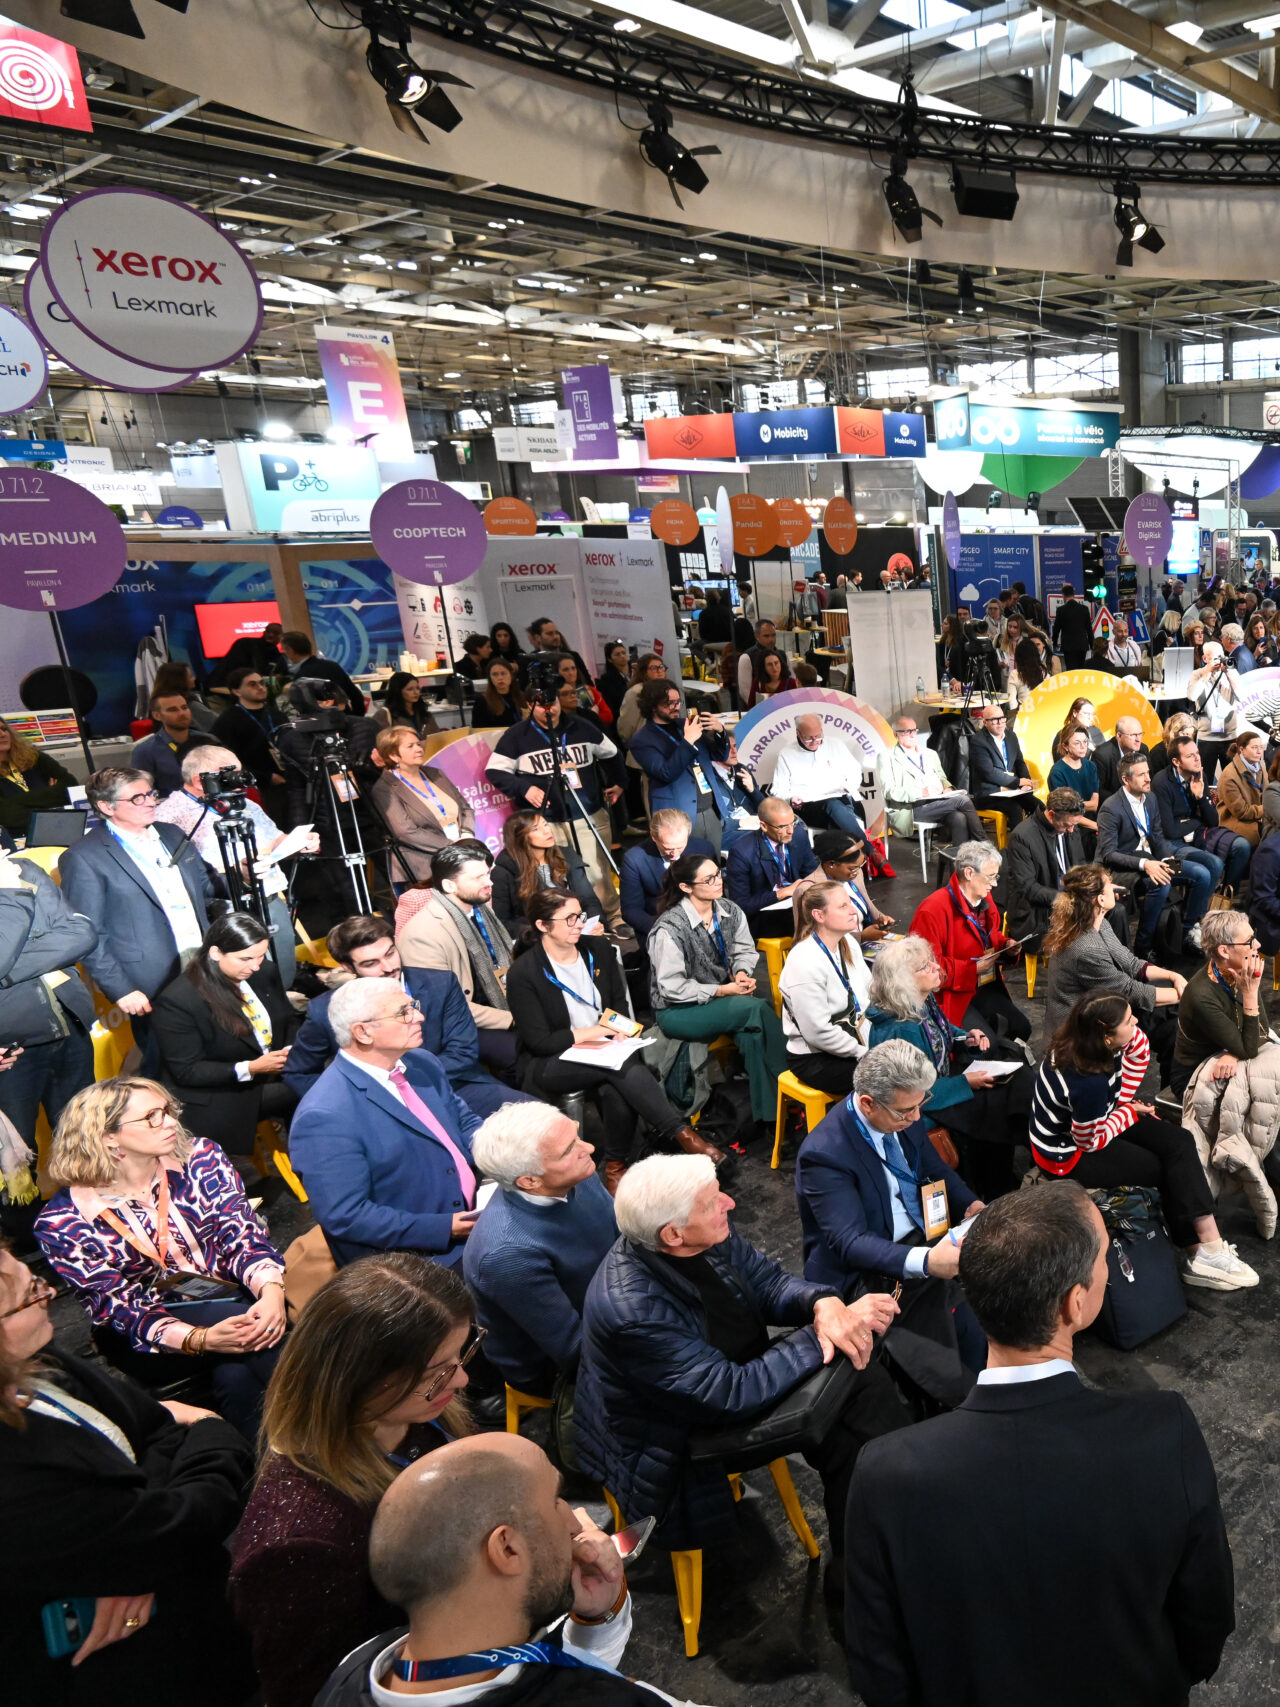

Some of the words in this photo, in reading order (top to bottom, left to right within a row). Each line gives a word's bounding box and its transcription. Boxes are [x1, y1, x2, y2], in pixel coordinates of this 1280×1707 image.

[92, 247, 222, 285] xerox
[112, 291, 217, 318] Lexmark
[381, 335, 390, 345] 4
[347, 381, 389, 424] E
[774, 426, 808, 440] Mobicity
[1083, 425, 1104, 435] vélo
[894, 437, 917, 447] Mobicity
[260, 453, 299, 491] P
[92, 483, 147, 491] BRIAND
[311, 511, 360, 525] abriplus
[1137, 521, 1162, 529] EVARISK
[1, 531, 97, 546] MEDNUM
[393, 527, 466, 539] COOPTECH
[1138, 530, 1161, 540] DigiRisk
[790, 542, 820, 557] ARCADE
[1016, 547, 1030, 555] CITY
[585, 552, 615, 566] xerox
[627, 556, 655, 567] Lexmark
[508, 563, 557, 576] xerox
[514, 582, 556, 592] Lexmark
